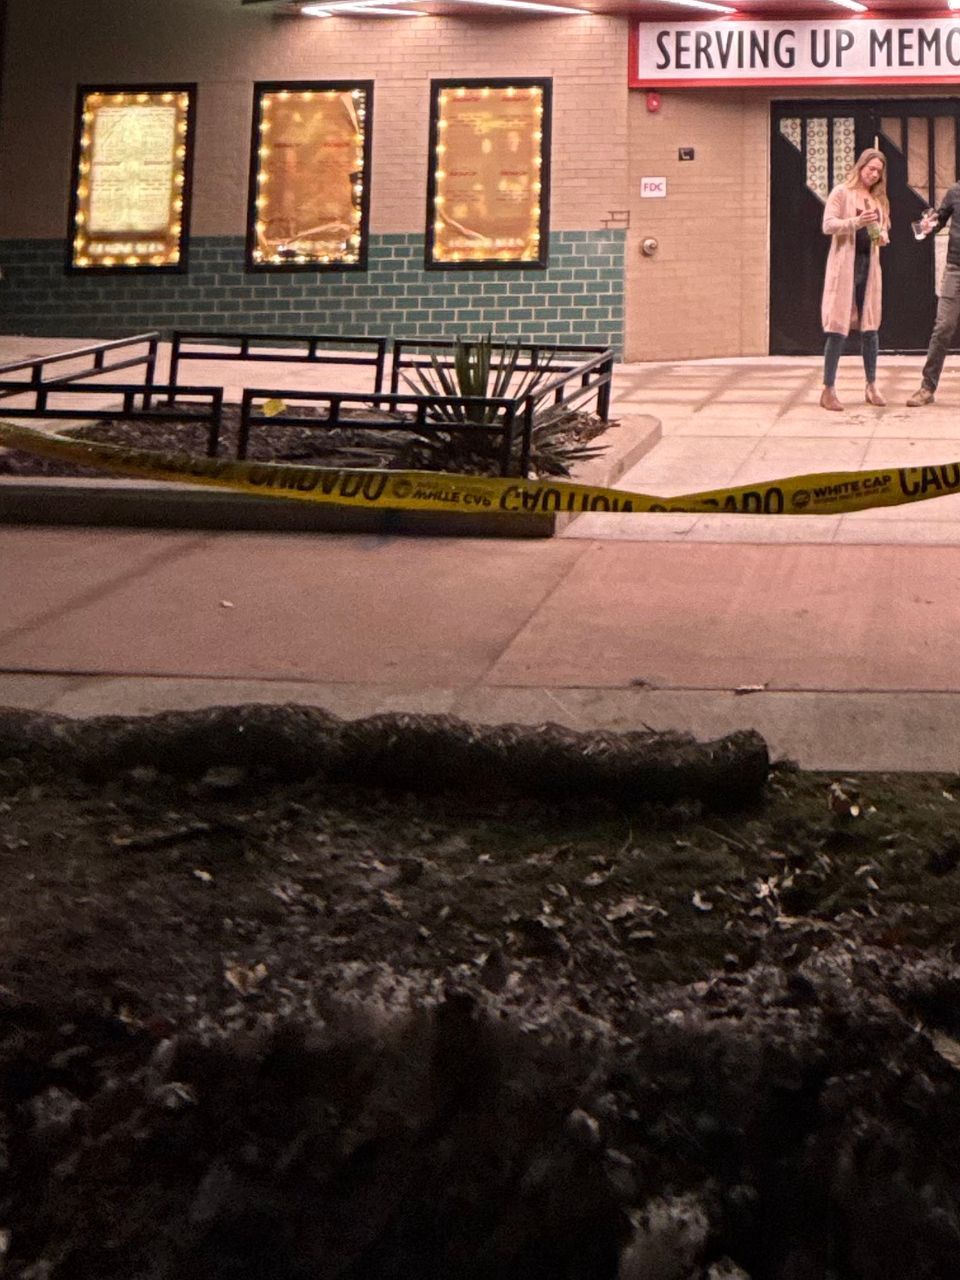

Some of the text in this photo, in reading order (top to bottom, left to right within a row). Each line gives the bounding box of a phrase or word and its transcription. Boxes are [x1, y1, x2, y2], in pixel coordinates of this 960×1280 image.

[656, 29, 796, 69] SERVING
[810, 28, 855, 68] UP
[643, 182, 664, 193] FDC
[812, 479, 860, 499] WHITE
[862, 474, 893, 491] CAP
